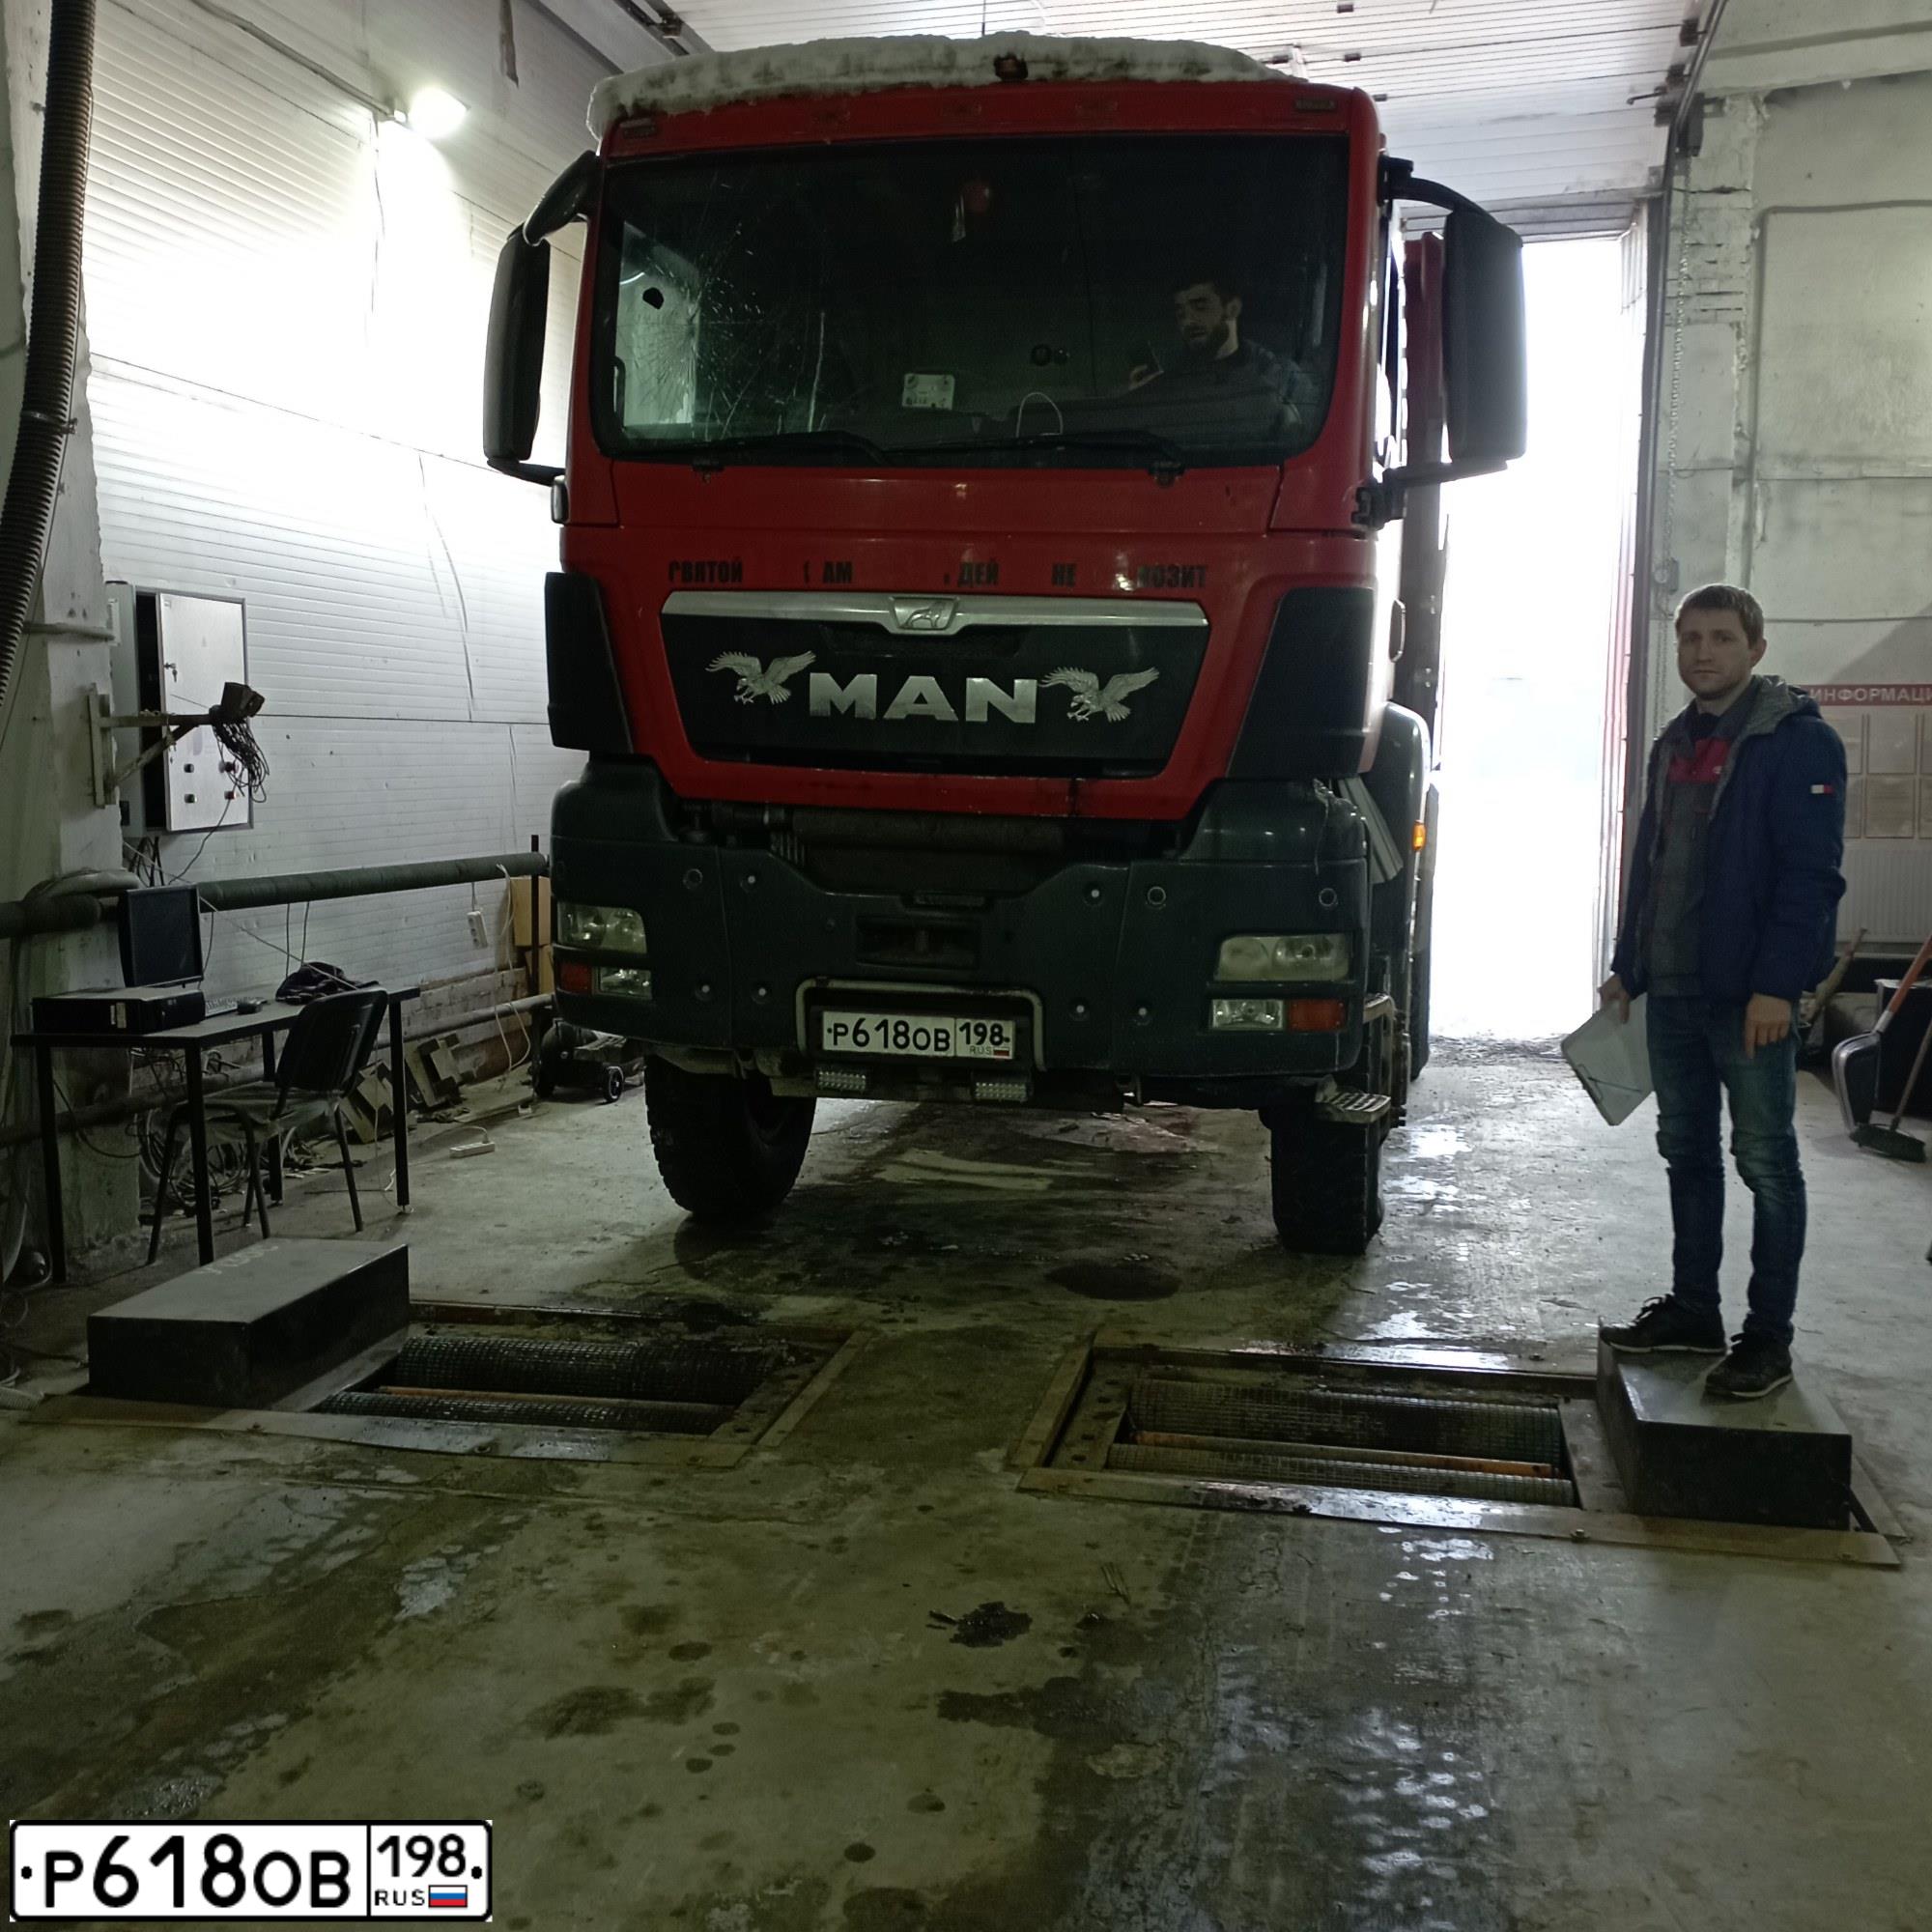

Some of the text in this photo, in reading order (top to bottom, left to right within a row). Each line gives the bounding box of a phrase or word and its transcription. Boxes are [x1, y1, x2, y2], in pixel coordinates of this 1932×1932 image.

[944, 557, 999, 587] ДЕЙ
[809, 672, 1037, 724] MAN
[959, 1022, 1003, 1045] 198
[969, 1045, 992, 1056] RUS
